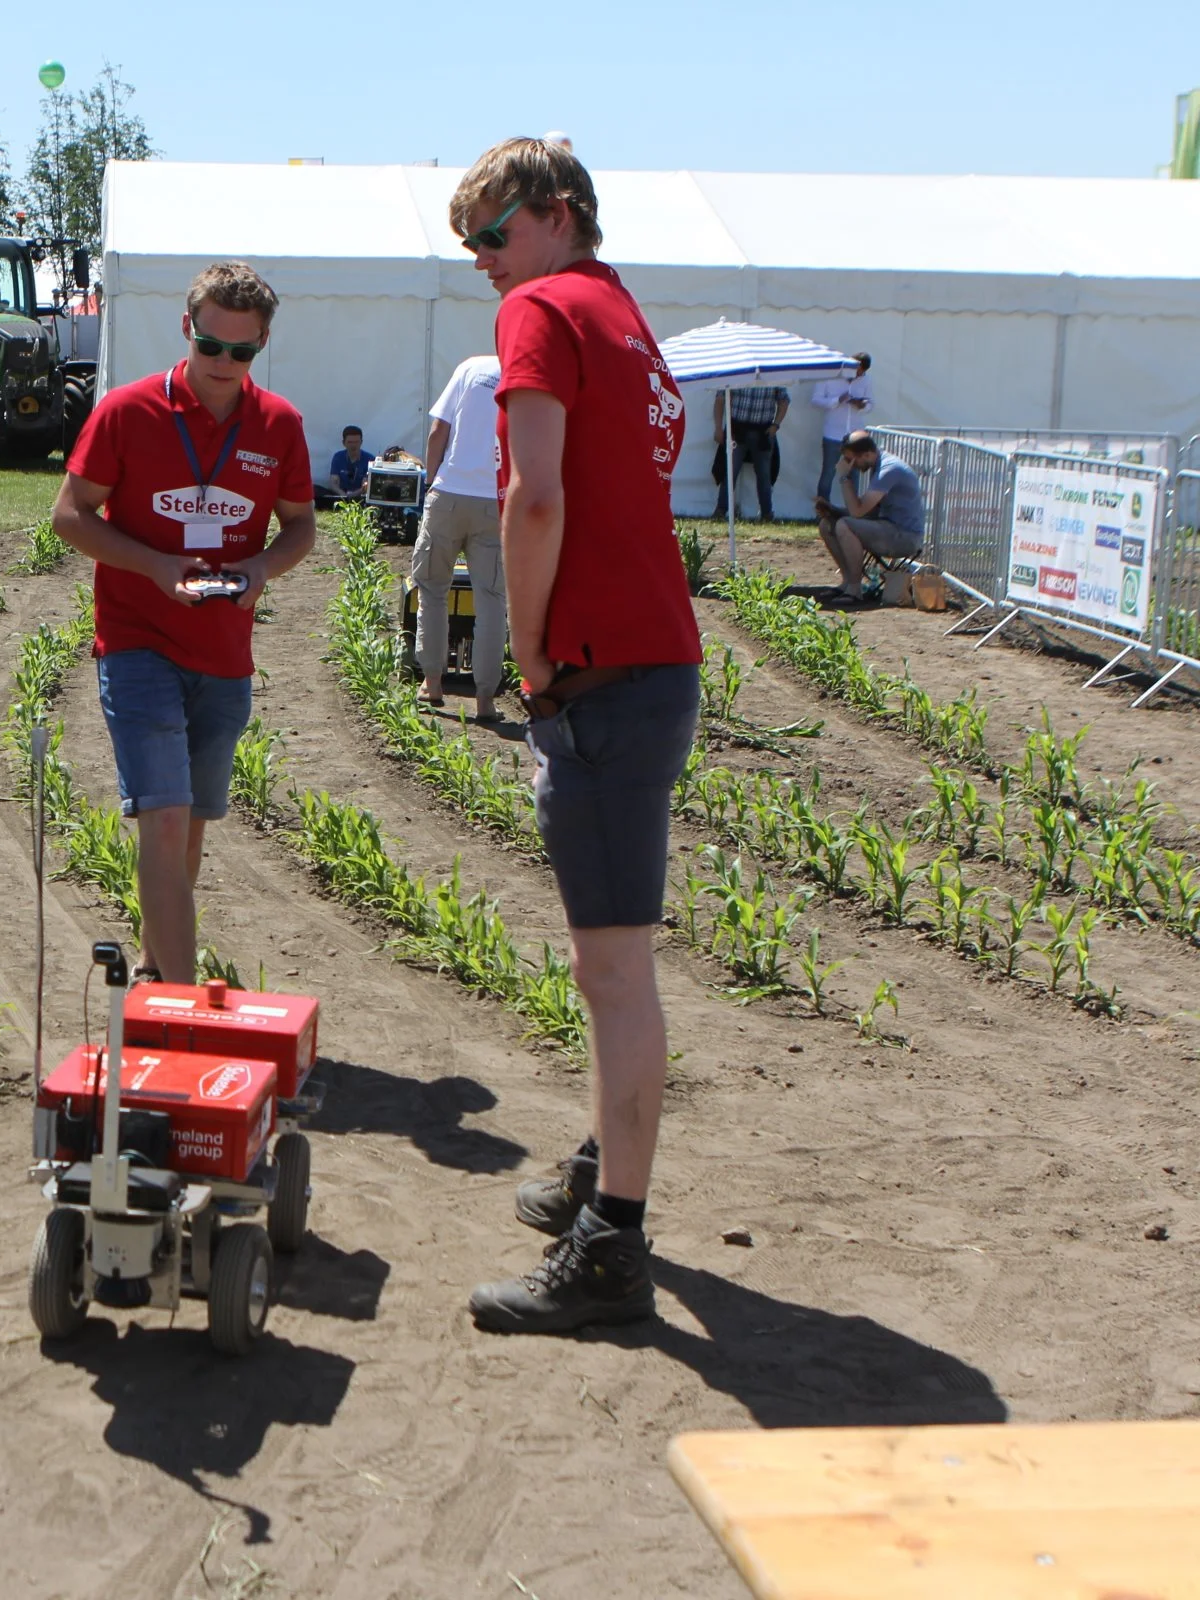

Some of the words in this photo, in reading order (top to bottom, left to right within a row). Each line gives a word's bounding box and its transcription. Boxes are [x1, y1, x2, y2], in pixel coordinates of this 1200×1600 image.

[241, 462, 271, 477] BullsEye
[160, 494, 246, 517] Steketee
[169, 1128, 224, 1146] neland
[178, 1143, 223, 1160] group
